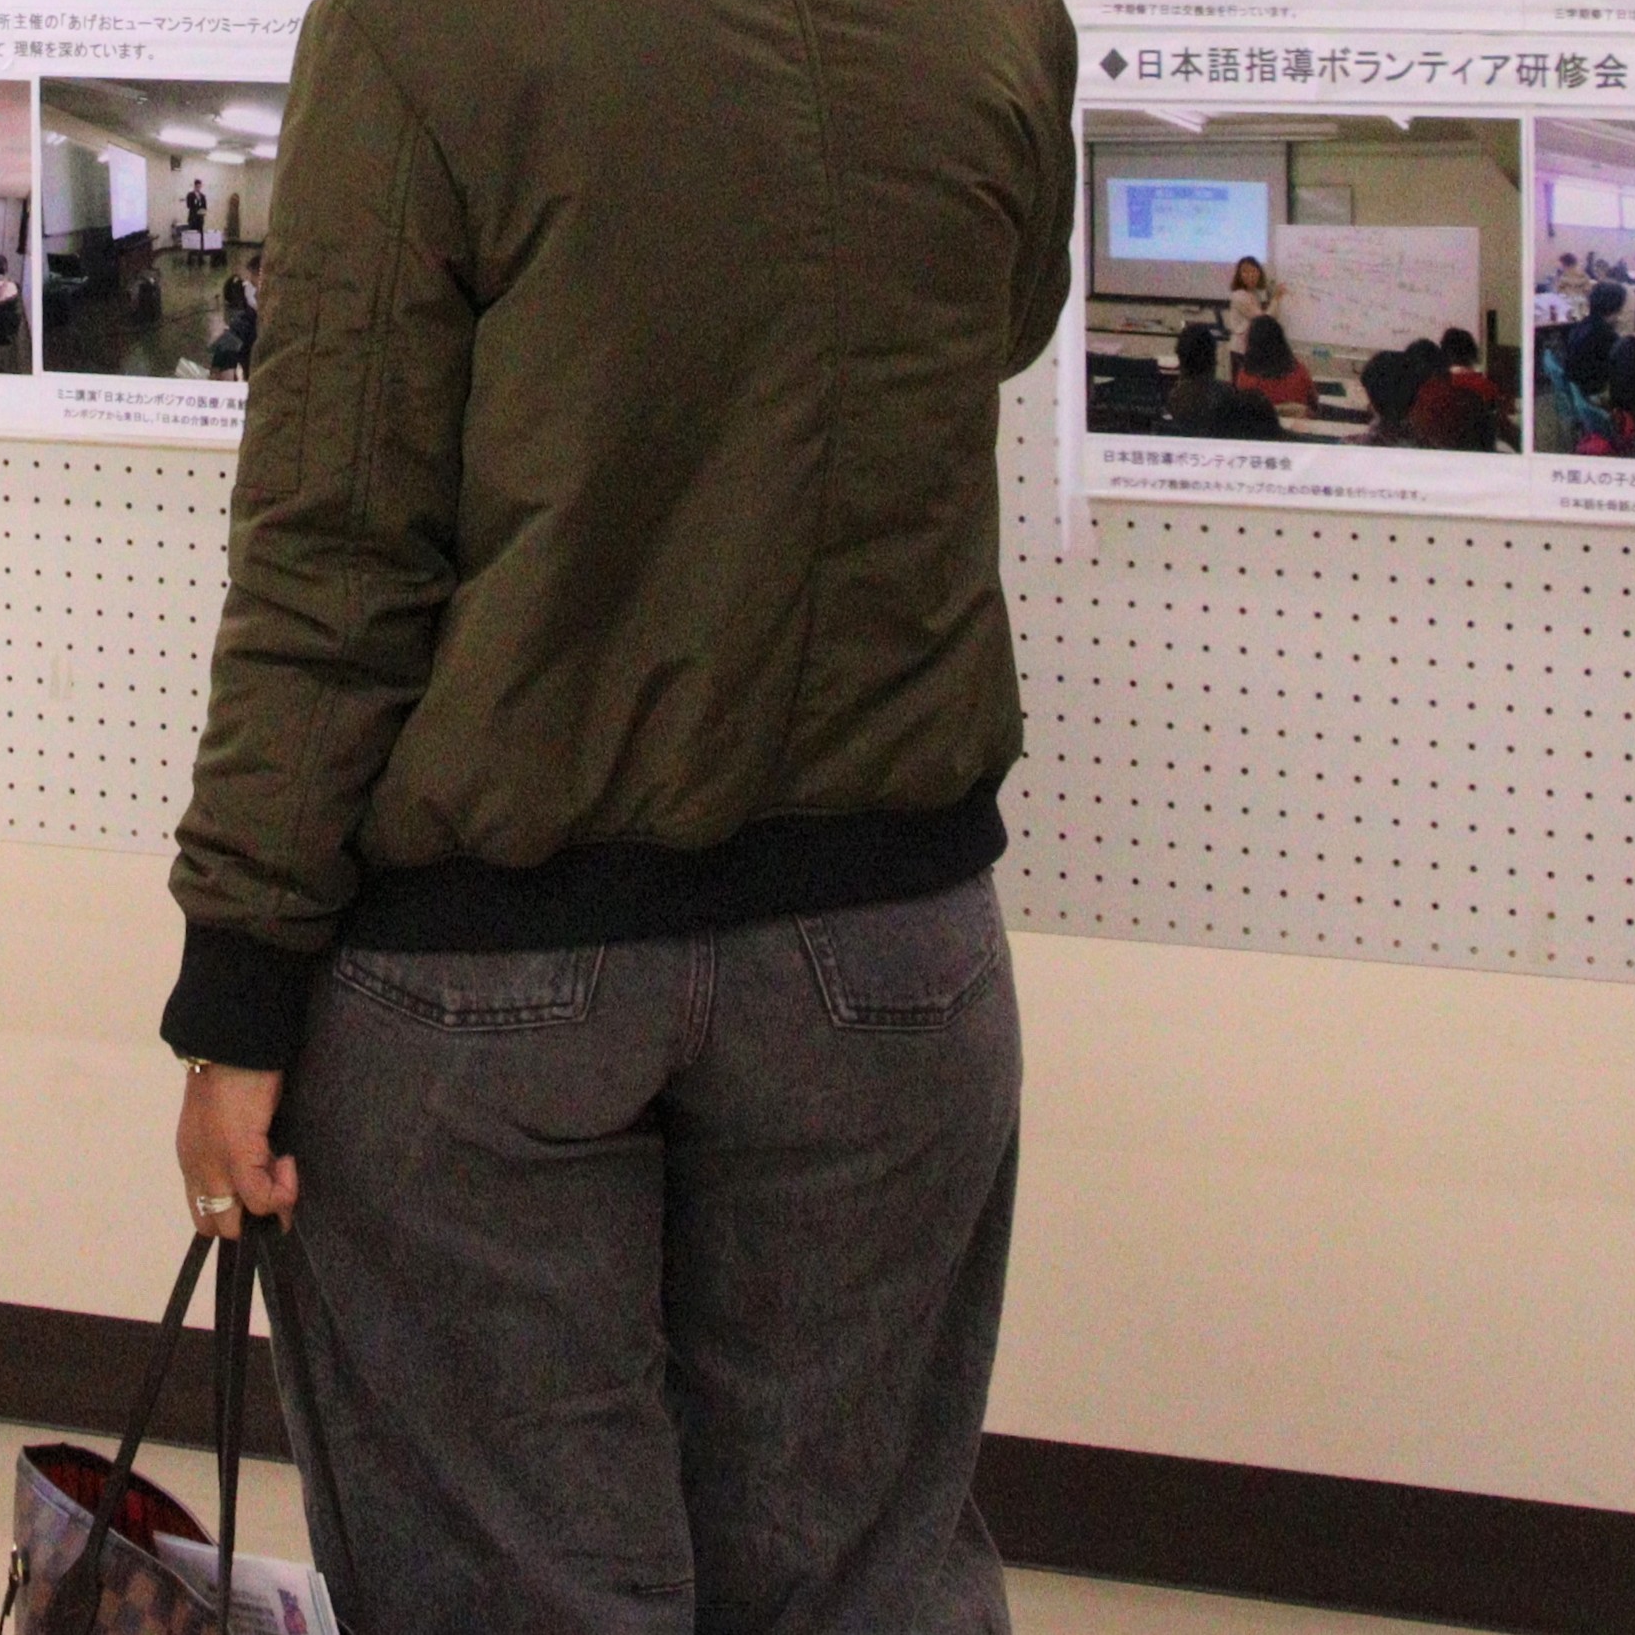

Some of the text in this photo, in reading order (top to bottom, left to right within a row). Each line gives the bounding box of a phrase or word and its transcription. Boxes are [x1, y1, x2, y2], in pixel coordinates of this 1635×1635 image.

[1137, 47, 1628, 89] 日本語指導ボランティア研修会
